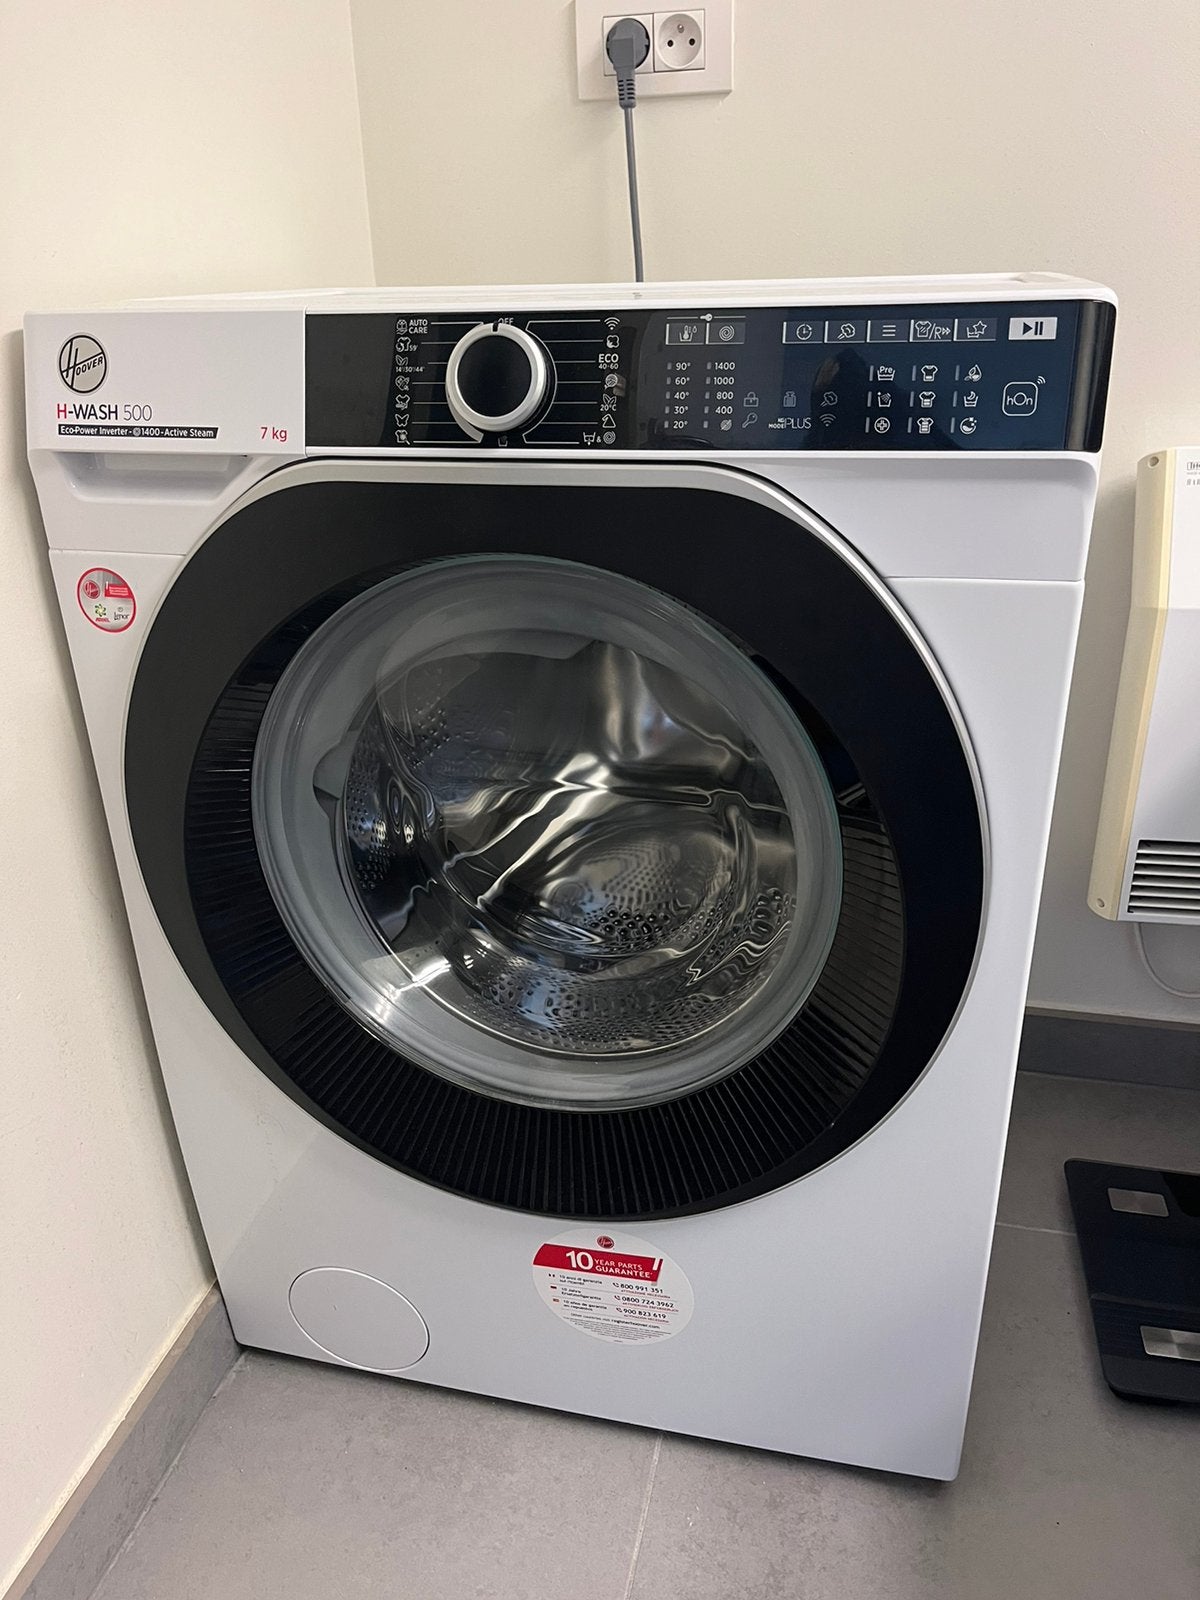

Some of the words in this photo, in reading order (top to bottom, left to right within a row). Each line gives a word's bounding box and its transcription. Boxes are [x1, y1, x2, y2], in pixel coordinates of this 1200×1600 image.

[598, 354, 619, 363] ECO
[61, 338, 105, 390] HOOVER
[675, 362, 691, 370] 90°
[714, 362, 735, 370] 1400
[879, 365, 893, 374] Pre
[675, 377, 690, 385] 60°
[713, 377, 735, 385] 1000
[674, 391, 690, 399] 40°
[716, 391, 734, 399] 800
[57, 403, 118, 420] H-WASH
[123, 404, 152, 422] 500
[673, 405, 689, 414] 30°
[715, 405, 733, 414] 400
[673, 420, 688, 429] 20°
[784, 417, 812, 429] PLUS
[60, 425, 97, 435] Eco-Power
[189, 427, 214, 438] Steam
[260, 427, 267, 440] 7
[272, 427, 288, 442] kg
[566, 1250, 594, 1270] 10
[594, 1258, 616, 1267] YEAR
[618, 1262, 643, 1271] PARTS
